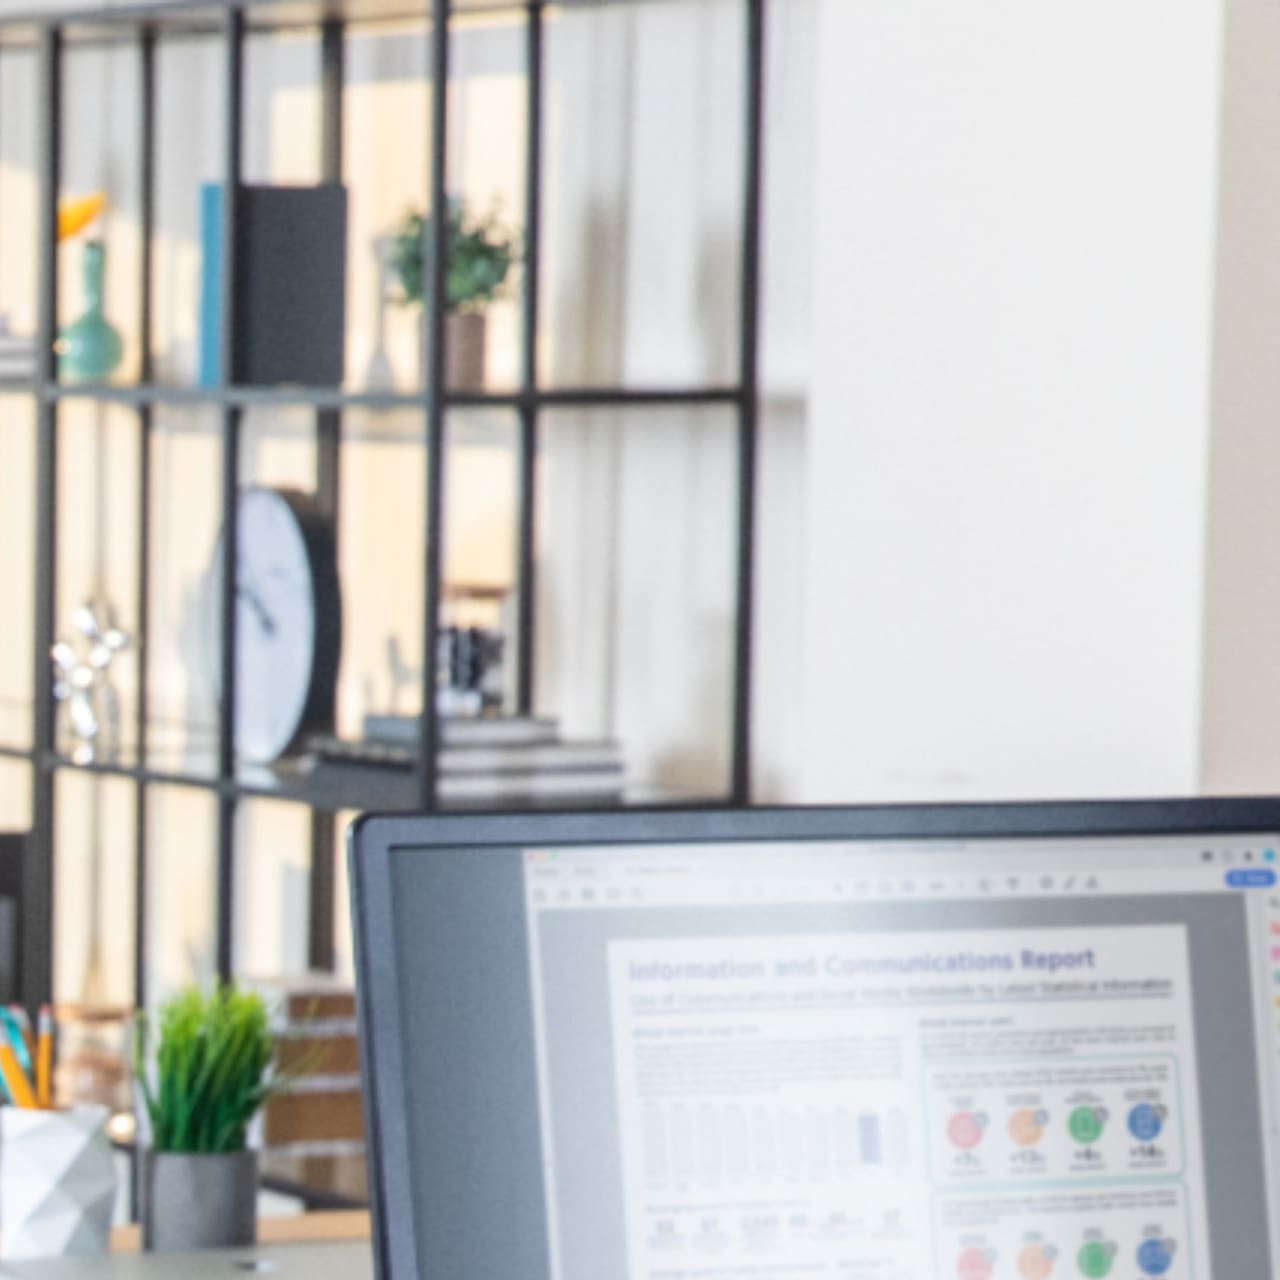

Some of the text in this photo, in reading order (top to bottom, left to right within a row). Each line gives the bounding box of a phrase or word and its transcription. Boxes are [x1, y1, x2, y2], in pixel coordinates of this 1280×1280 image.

[628, 949, 1096, 982] Information and Communications Report
